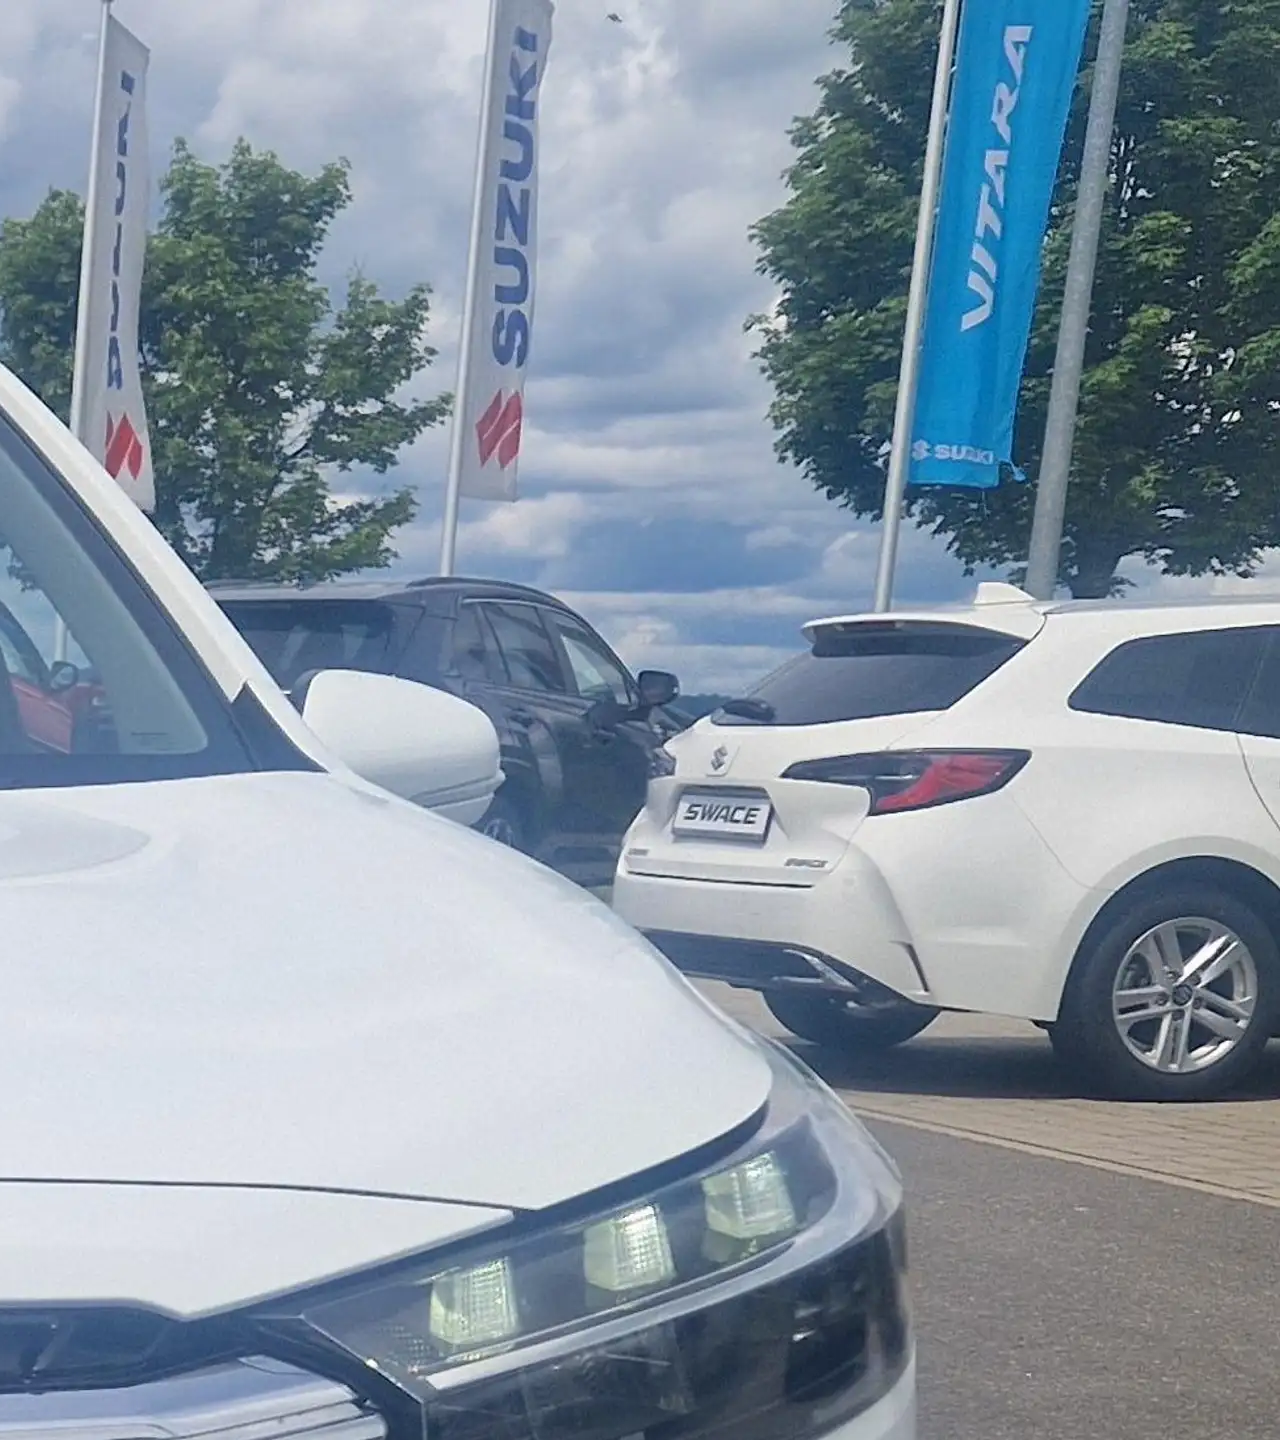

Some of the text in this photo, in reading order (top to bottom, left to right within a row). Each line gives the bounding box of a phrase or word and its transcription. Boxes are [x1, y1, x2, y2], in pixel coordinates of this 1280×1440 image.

[492, 25, 538, 369] SUZUKI
[960, 25, 1033, 332] VITARA
[683, 803, 761, 825] SWACE
